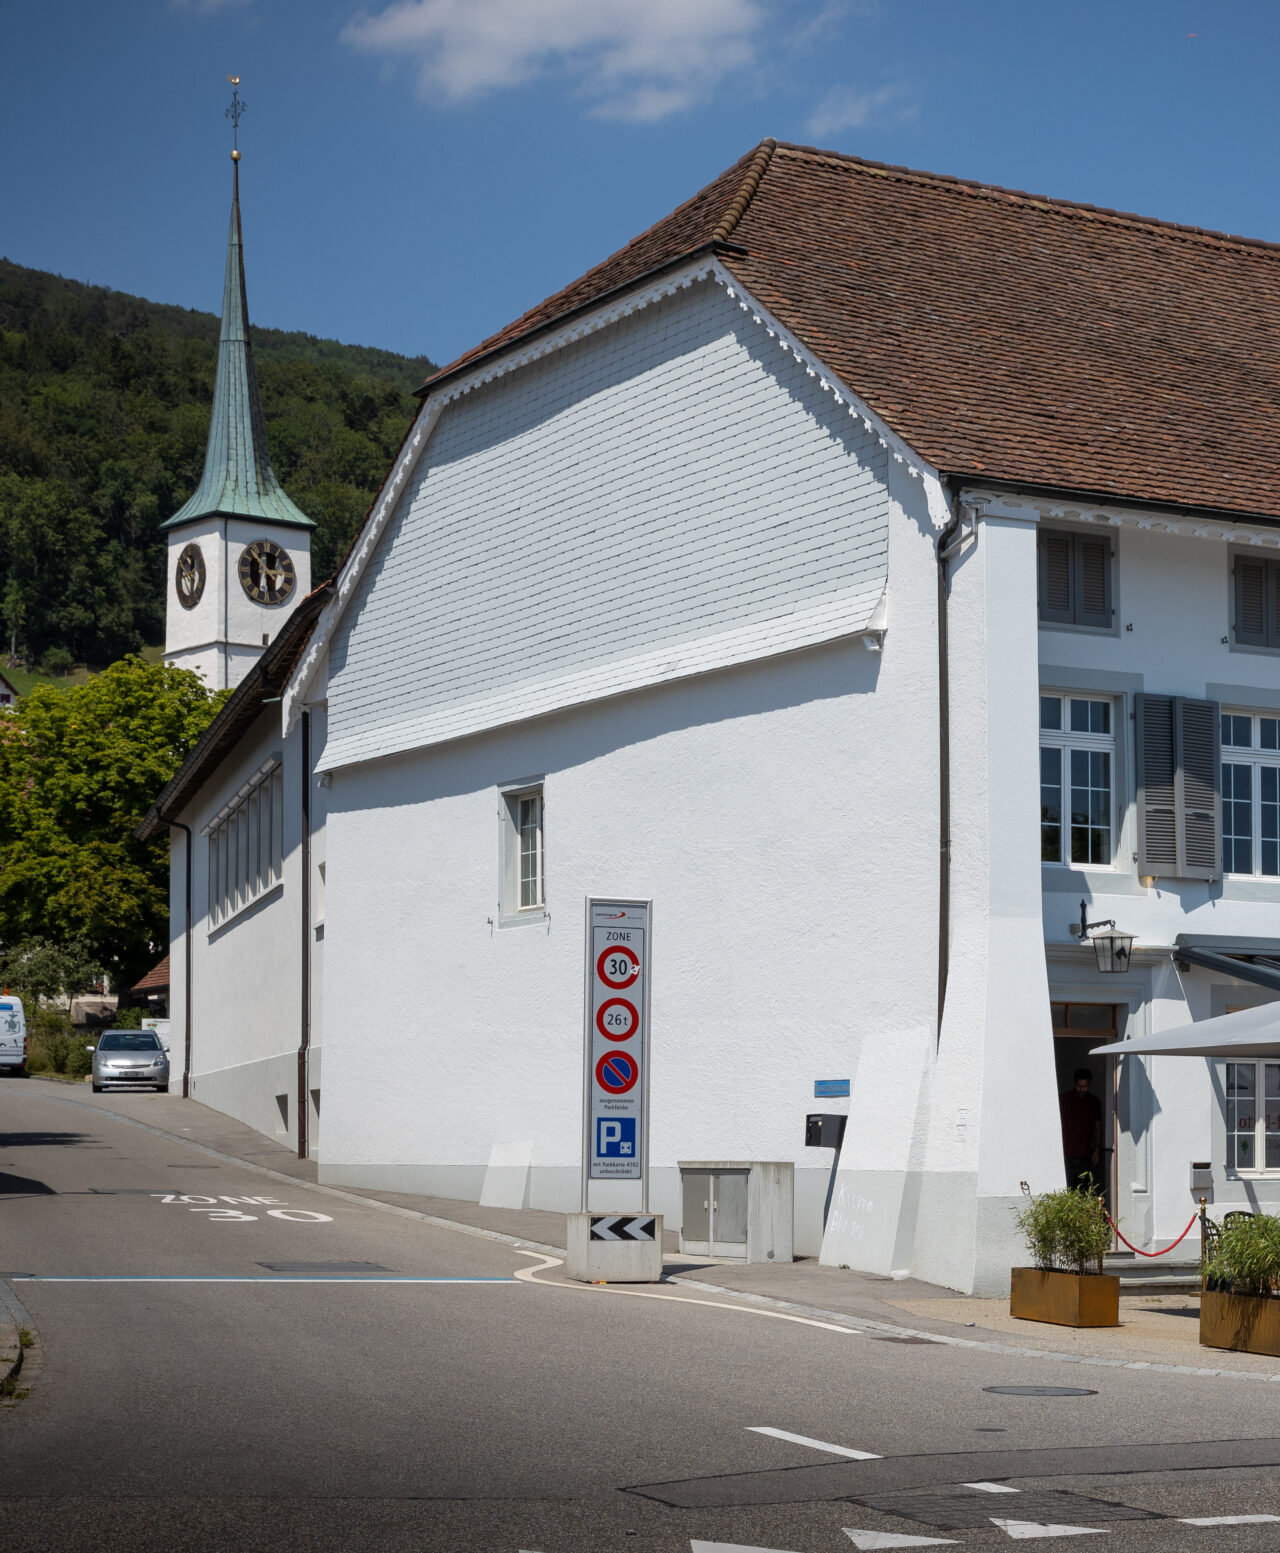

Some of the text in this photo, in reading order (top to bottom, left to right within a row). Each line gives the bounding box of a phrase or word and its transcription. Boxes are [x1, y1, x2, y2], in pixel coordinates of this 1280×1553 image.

[606, 931, 632, 942] ZONE
[609, 959, 628, 976] 30
[600, 1121, 622, 1154] P
[149, 1194, 289, 1205] ZONE
[189, 1208, 334, 1223] 30
